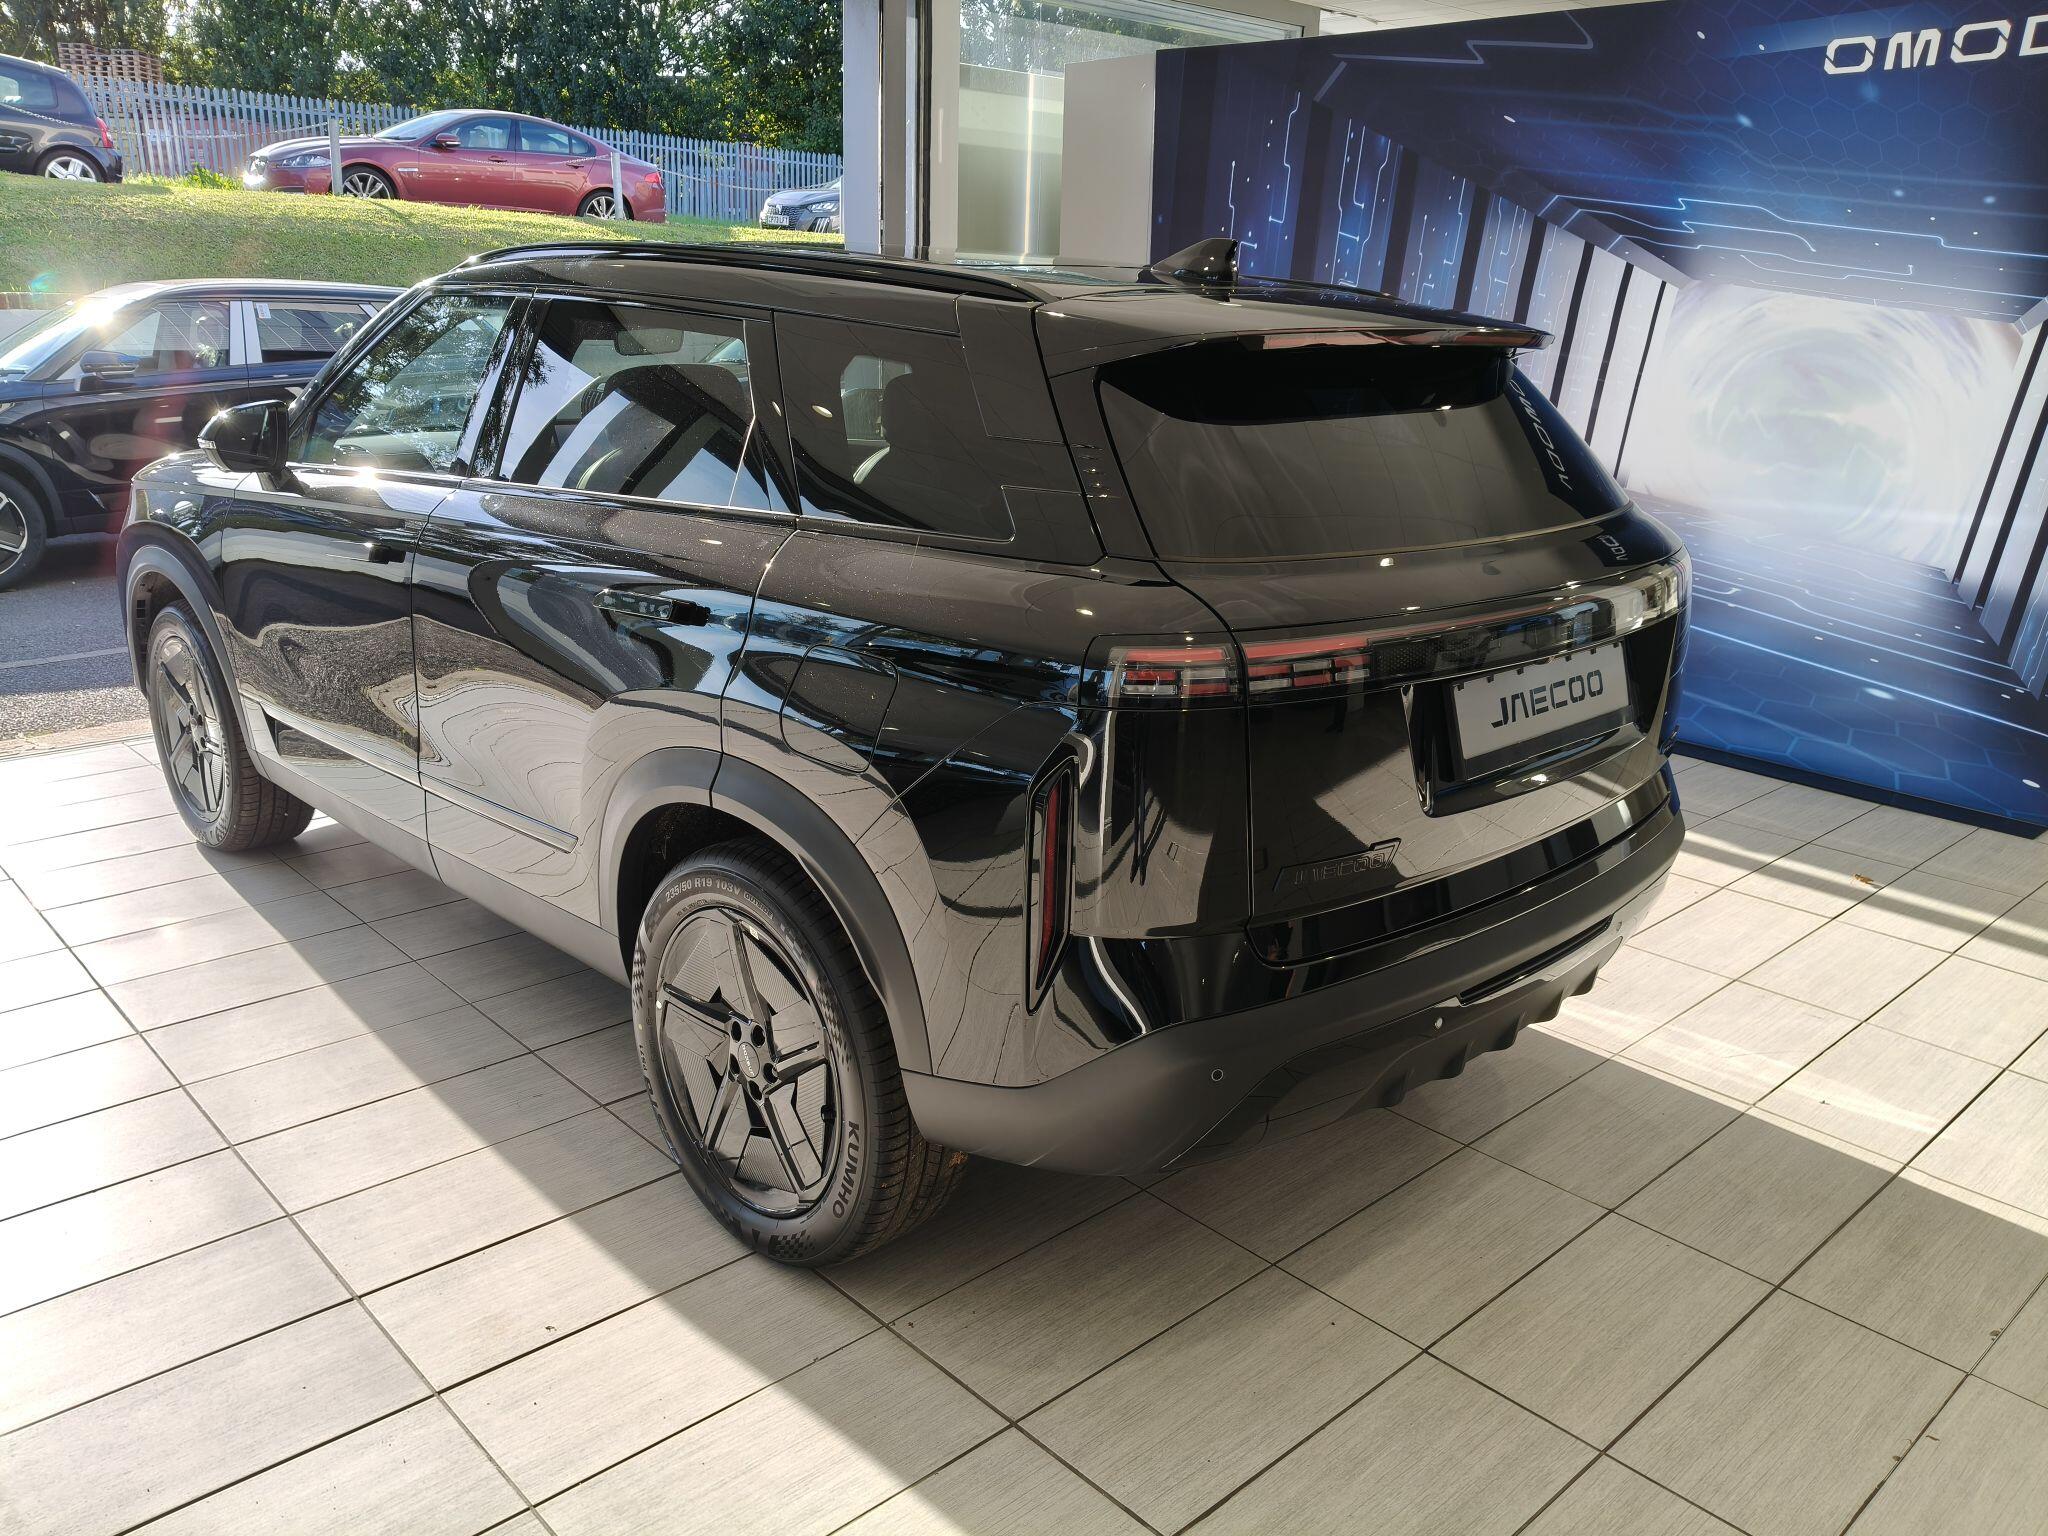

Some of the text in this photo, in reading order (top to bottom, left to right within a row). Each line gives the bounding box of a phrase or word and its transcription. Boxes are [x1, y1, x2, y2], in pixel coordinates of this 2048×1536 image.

[1491, 669, 1603, 728] JAECOO
[665, 879, 692, 902] 235/50
[694, 877, 713, 888] R19
[716, 880, 741, 896] 103V
[832, 1120, 860, 1219] KUMHO
